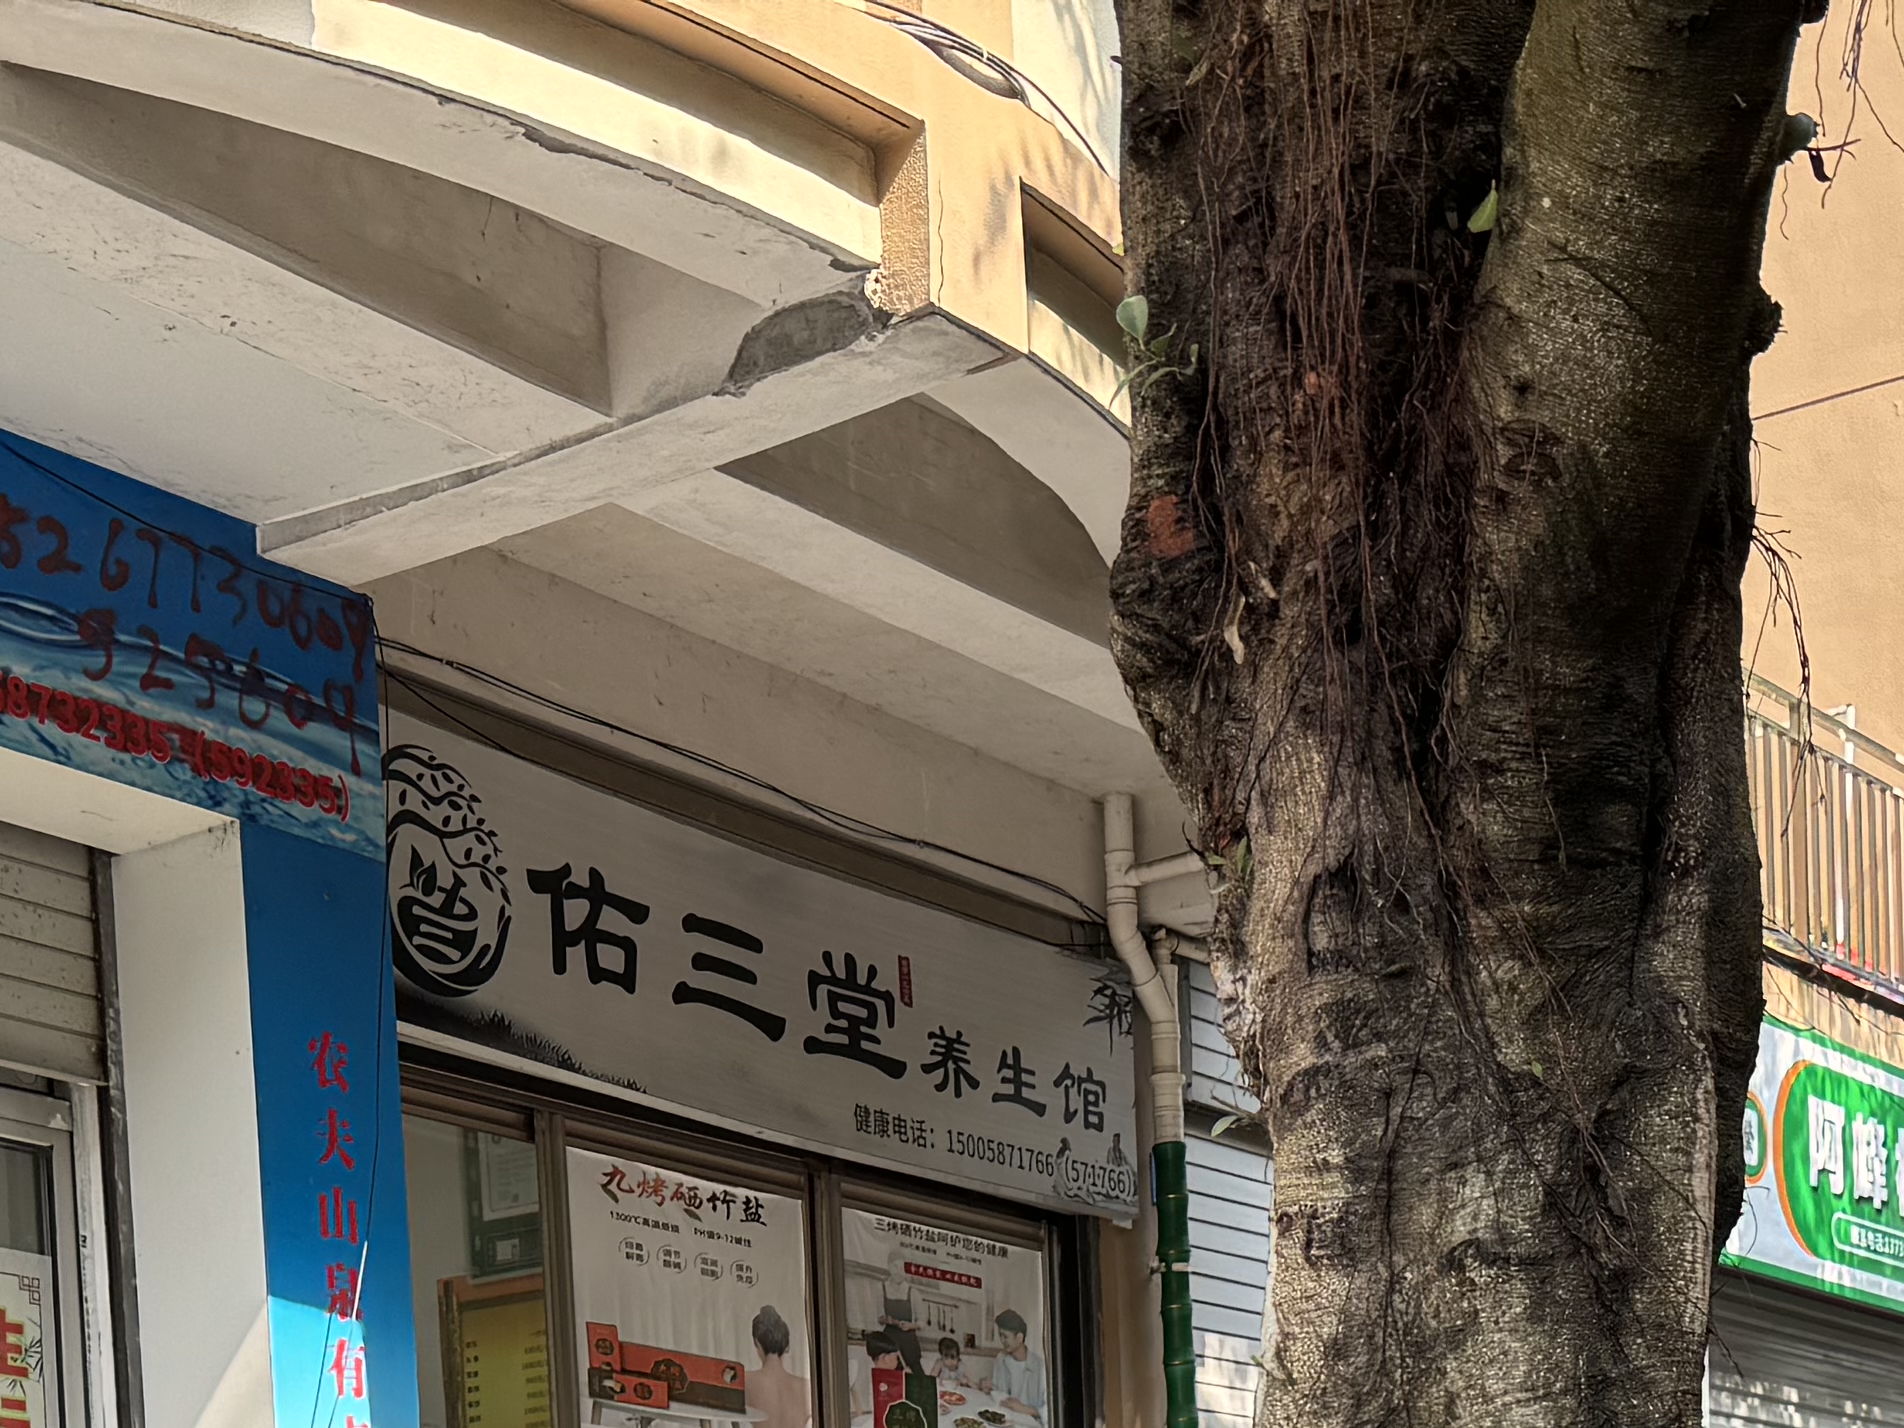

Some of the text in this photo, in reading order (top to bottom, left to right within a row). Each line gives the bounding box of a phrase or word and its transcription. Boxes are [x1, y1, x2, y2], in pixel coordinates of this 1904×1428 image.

[526, 862, 1107, 1133] 佑三堂 养生馆
